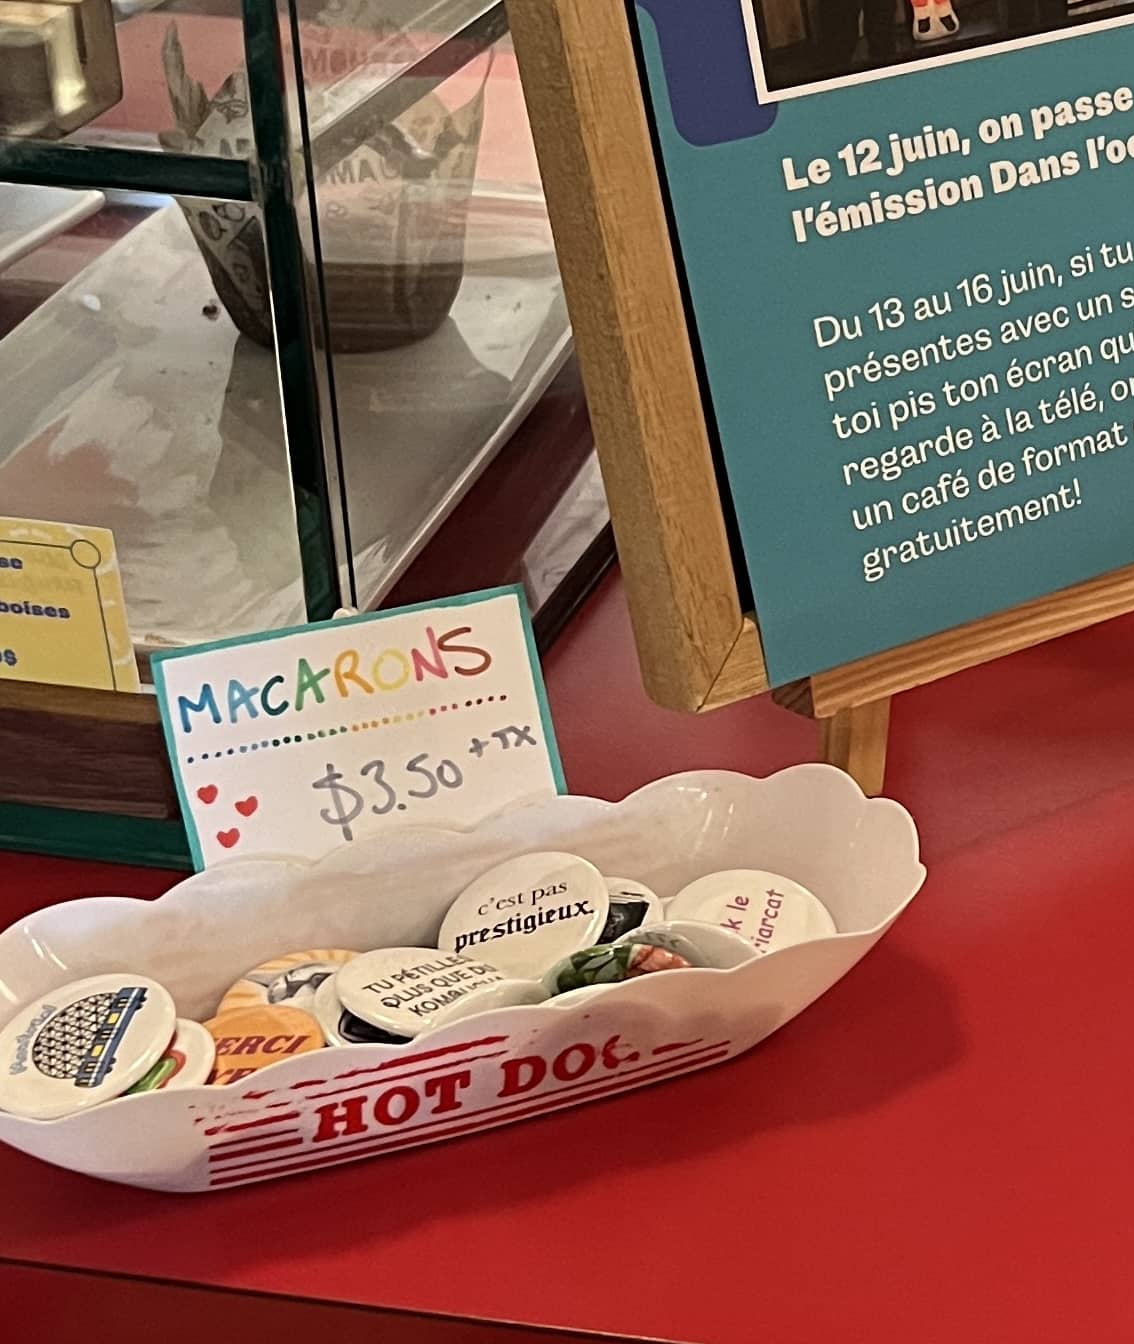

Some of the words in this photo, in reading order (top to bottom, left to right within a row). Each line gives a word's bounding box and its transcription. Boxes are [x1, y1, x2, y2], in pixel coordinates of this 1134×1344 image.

[782, 157, 832, 191] Le
[837, 138, 883, 177] 12
[885, 124, 971, 177] juin,
[978, 112, 1024, 144] on
[1030, 86, 1134, 140] passe
[791, 174, 984, 243] l'émission
[989, 150, 1081, 194] Dans
[813, 315, 863, 348] Du
[867, 297, 905, 331] 13
[913, 291, 952, 321] au
[956, 273, 993, 307] 16
[997, 262, 1063, 306] juin,
[1070, 246, 1094, 278] si
[1100, 241, 1134, 268] tu
[824, 328, 993, 402] présentes
[1000, 306, 1070, 344] avec
[1076, 293, 1113, 321] un
[831, 401, 881, 439] toi
[888, 390, 936, 431] pis
[941, 373, 999, 407] ton
[1006, 345, 1093, 388] écran
[842, 425, 974, 486] regarde
[981, 414, 1002, 443] à
[1006, 407, 1035, 435] la
[1037, 382, 1104, 424] télé,
[852, 500, 894, 530] un
[901, 468, 970, 514] café
[977, 459, 1016, 490] de
[1021, 421, 1129, 476] format
[863, 477, 1082, 582] gratuitement!
[177, 626, 492, 733] MACARONS
[312, 752, 465, 841] $3.50
[454, 900, 596, 955] prestigieux.
[478, 890, 525, 917] c'est
[531, 881, 569, 906] pas
[726, 895, 750, 912] le
[361, 978, 395, 995] TU
[430, 968, 473, 988] QUE
[468, 963, 498, 976] DU
[214, 1034, 312, 1056] ERCI
[312, 1069, 472, 1144] HOT
[497, 1034, 642, 1098] DOG
